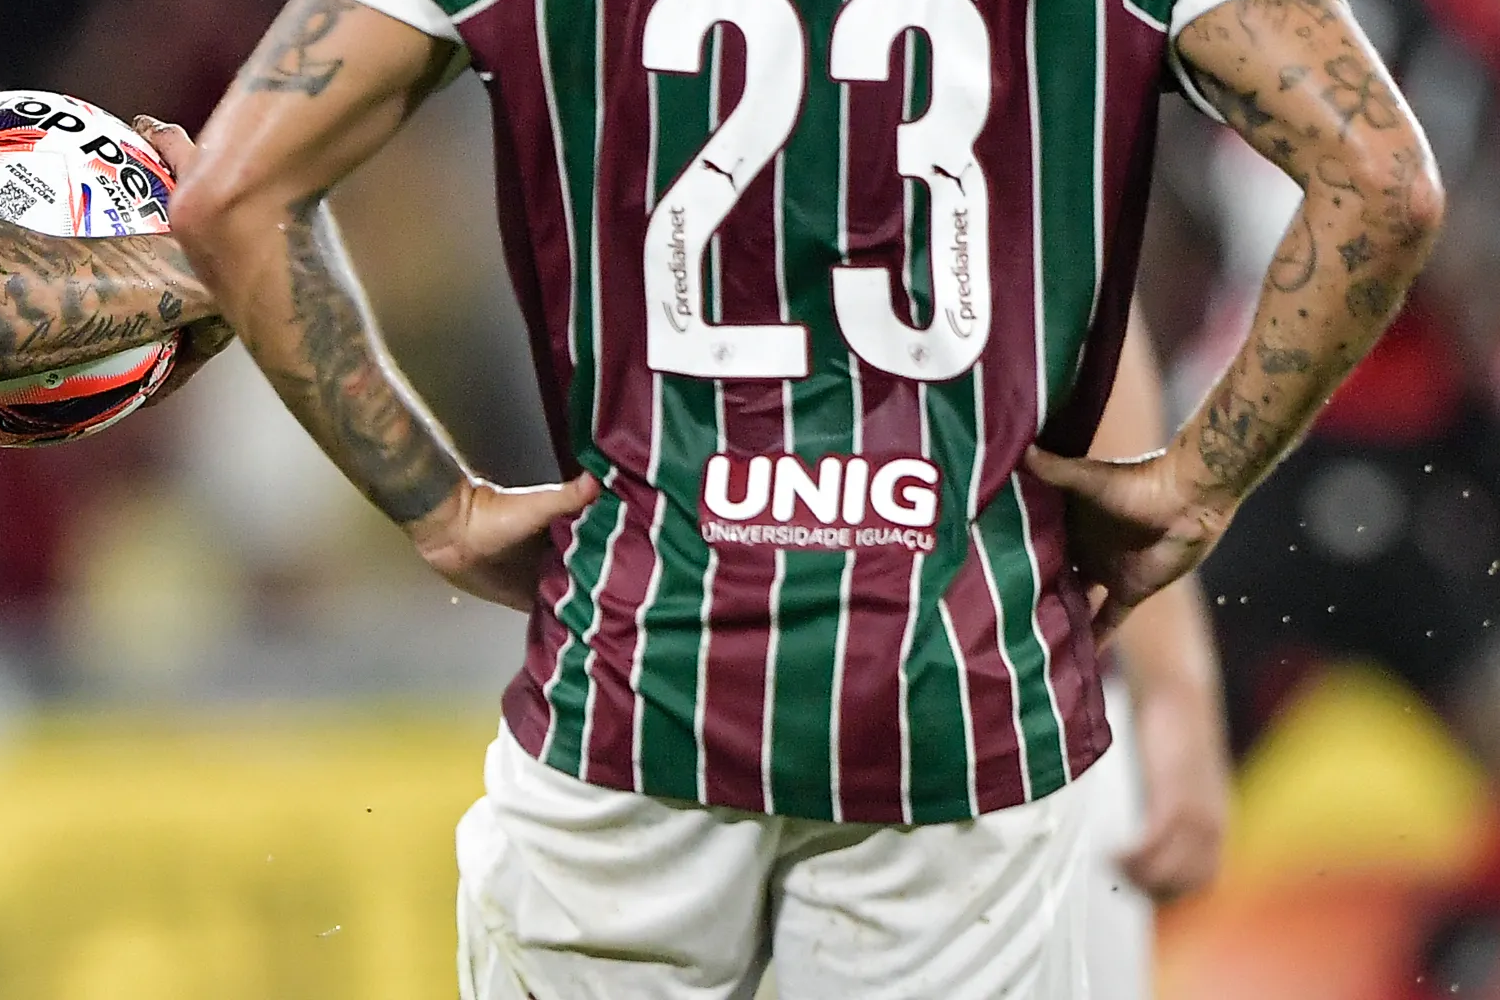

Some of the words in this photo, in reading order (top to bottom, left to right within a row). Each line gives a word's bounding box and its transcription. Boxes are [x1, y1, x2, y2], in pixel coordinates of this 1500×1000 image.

[95, 174, 137, 236] SAMBA
[103, 208, 128, 237] PR
[703, 454, 939, 527] UNIG
[701, 522, 850, 548] UNIVERSIDADE
[855, 527, 935, 551] IGUAÇU
